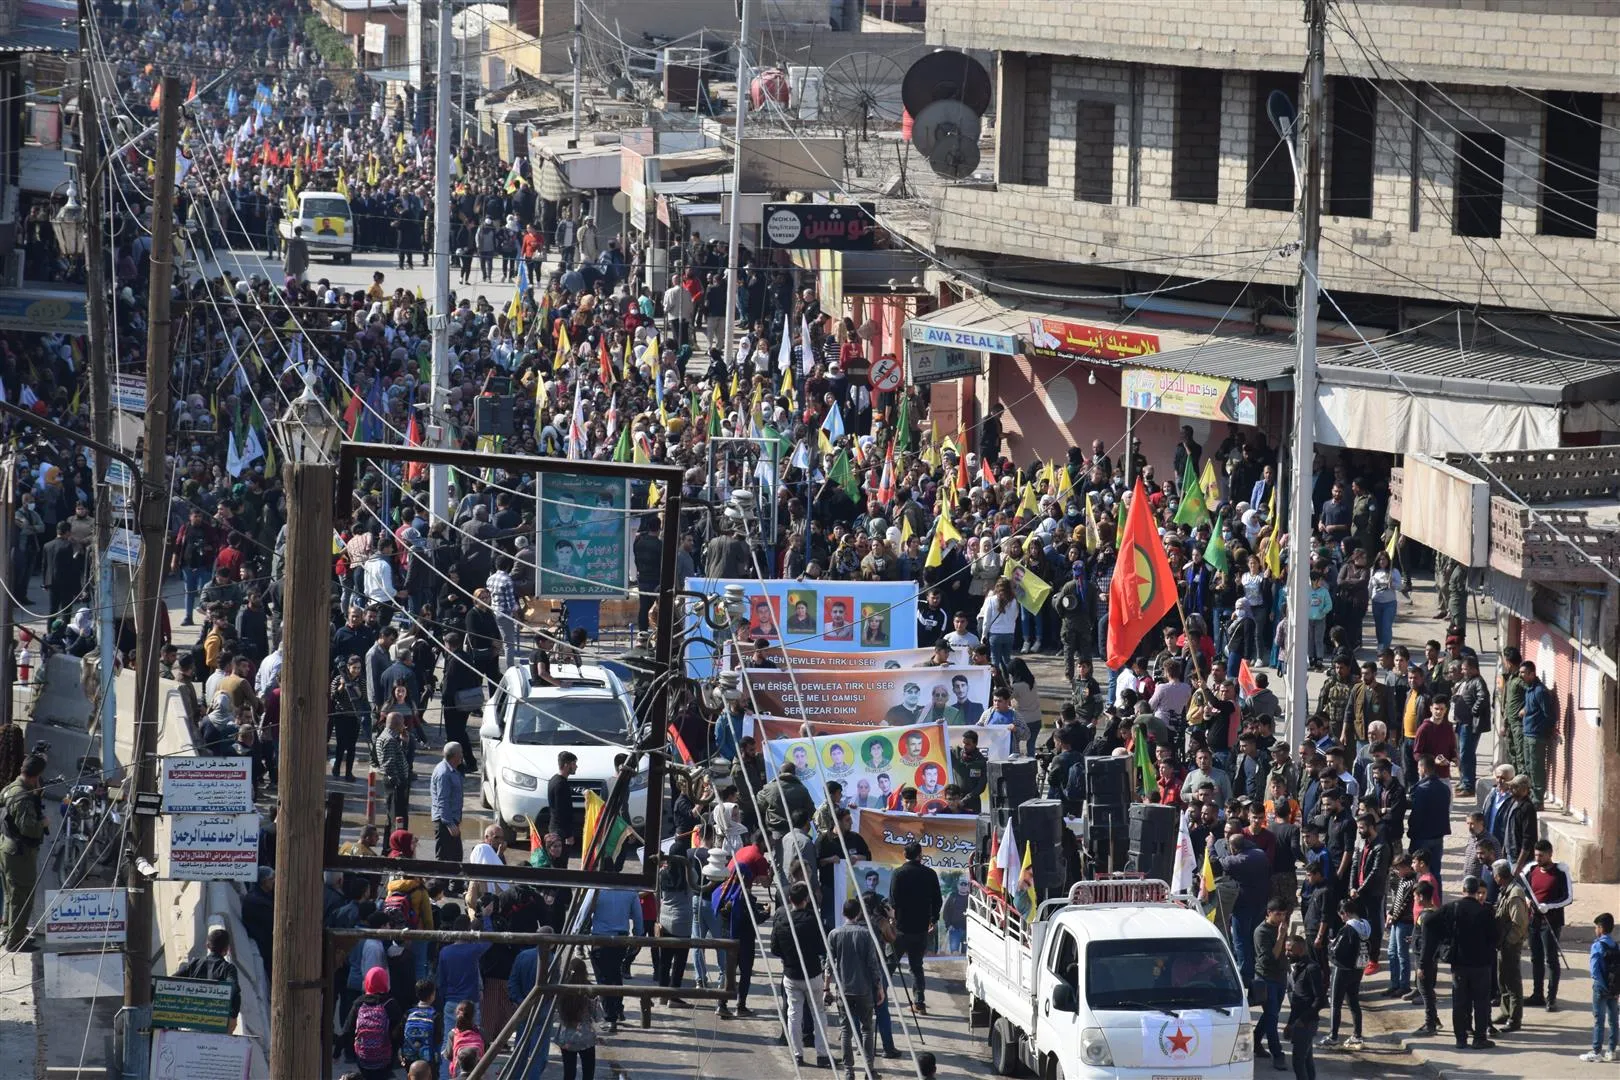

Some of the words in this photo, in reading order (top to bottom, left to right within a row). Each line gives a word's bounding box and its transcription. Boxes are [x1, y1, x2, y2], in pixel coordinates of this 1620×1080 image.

[929, 330, 952, 343] AVA
[955, 334, 994, 348] ZELAL
[1106, 335, 1156, 356] بلاستيك
[1202, 383, 1218, 396] مركز
[753, 683, 766, 691] EM
[801, 683, 843, 691] DEWLETA
[845, 682, 865, 690] TIRK
[866, 682, 874, 690] LI
[876, 682, 894, 690] SER
[807, 694, 820, 702] ME
[822, 694, 829, 702] LI
[196, 759, 217, 769] فراس
[198, 817, 234, 826] الدكتور
[171, 827, 200, 846] الرحمن
[937, 834, 976, 854] جزرة
[70, 893, 100, 903] الدكتورة
[186, 985, 208, 994] تقويم
[209, 986, 230, 996] عيادة
